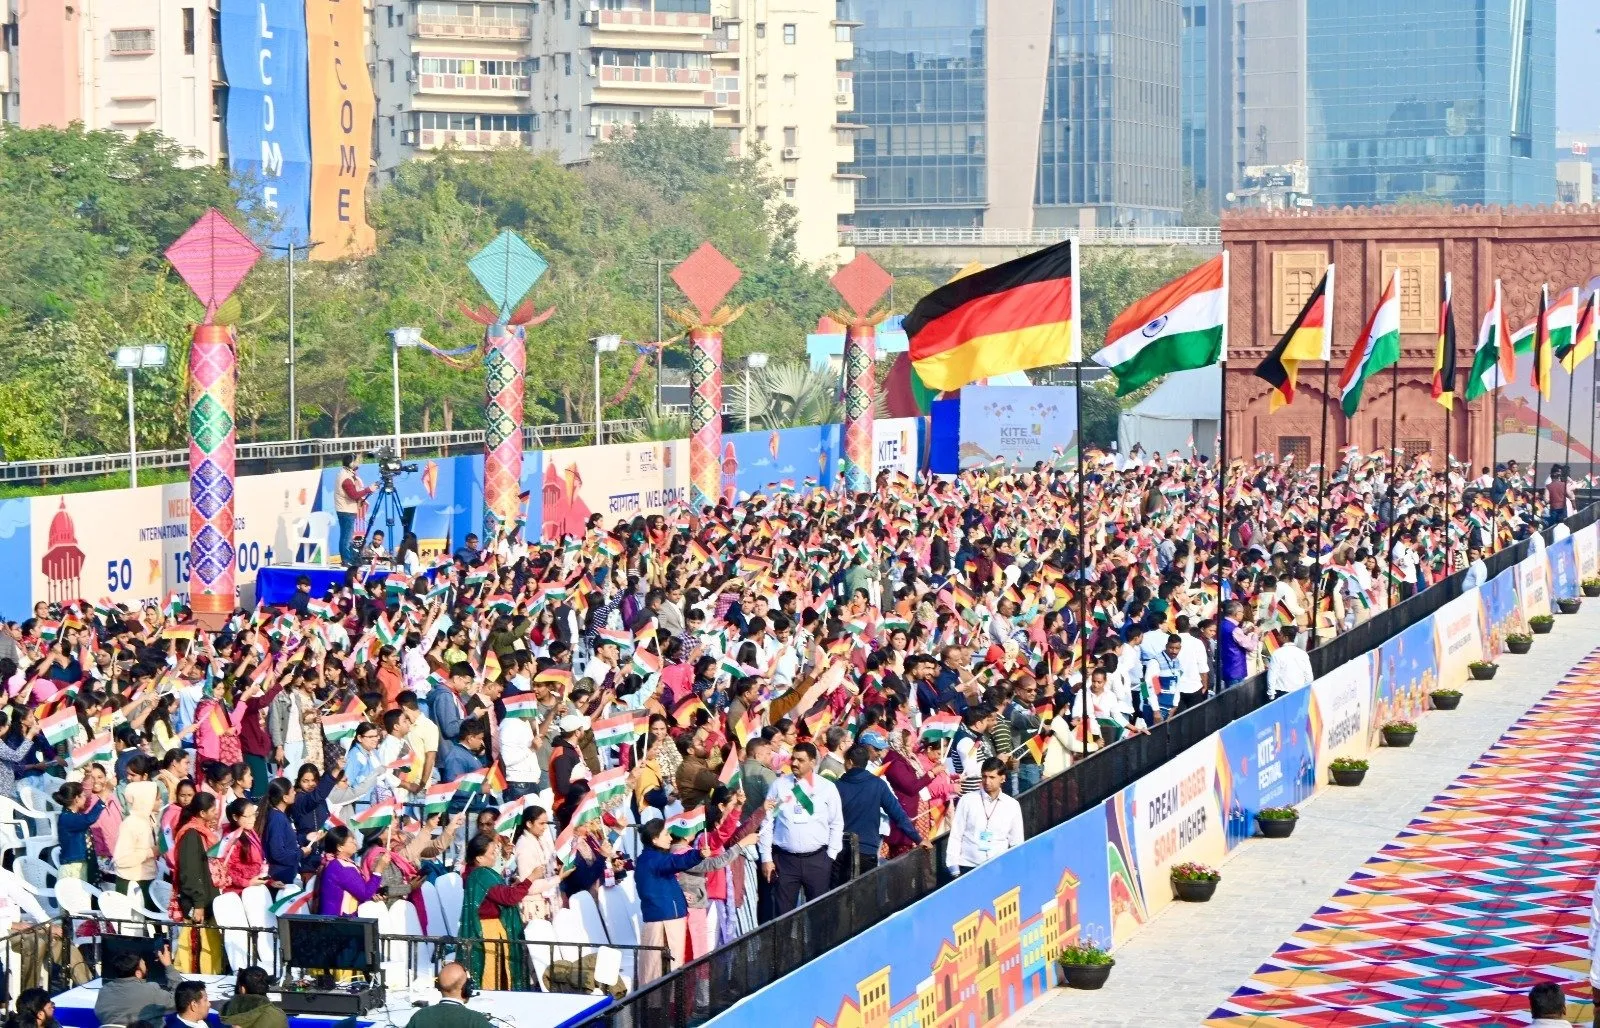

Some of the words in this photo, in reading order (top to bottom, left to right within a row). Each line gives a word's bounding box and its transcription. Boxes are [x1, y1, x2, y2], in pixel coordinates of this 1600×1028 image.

[1000, 427, 1027, 437] KITE
[1000, 437, 1041, 445] FESTIVAL
[640, 451, 652, 462] KITE
[879, 439, 898, 462] KITE
[645, 486, 685, 508] WELCOME
[139, 524, 189, 541] INTERNATIONAL
[108, 558, 132, 592] 50
[1257, 736, 1275, 768] KITE
[1258, 761, 1283, 791] FESTIVAL
[1149, 784, 1179, 829] DREAM
[1180, 766, 1206, 808] BIGGER
[1154, 827, 1177, 867] SOAR
[1179, 805, 1207, 850] HIGHER
